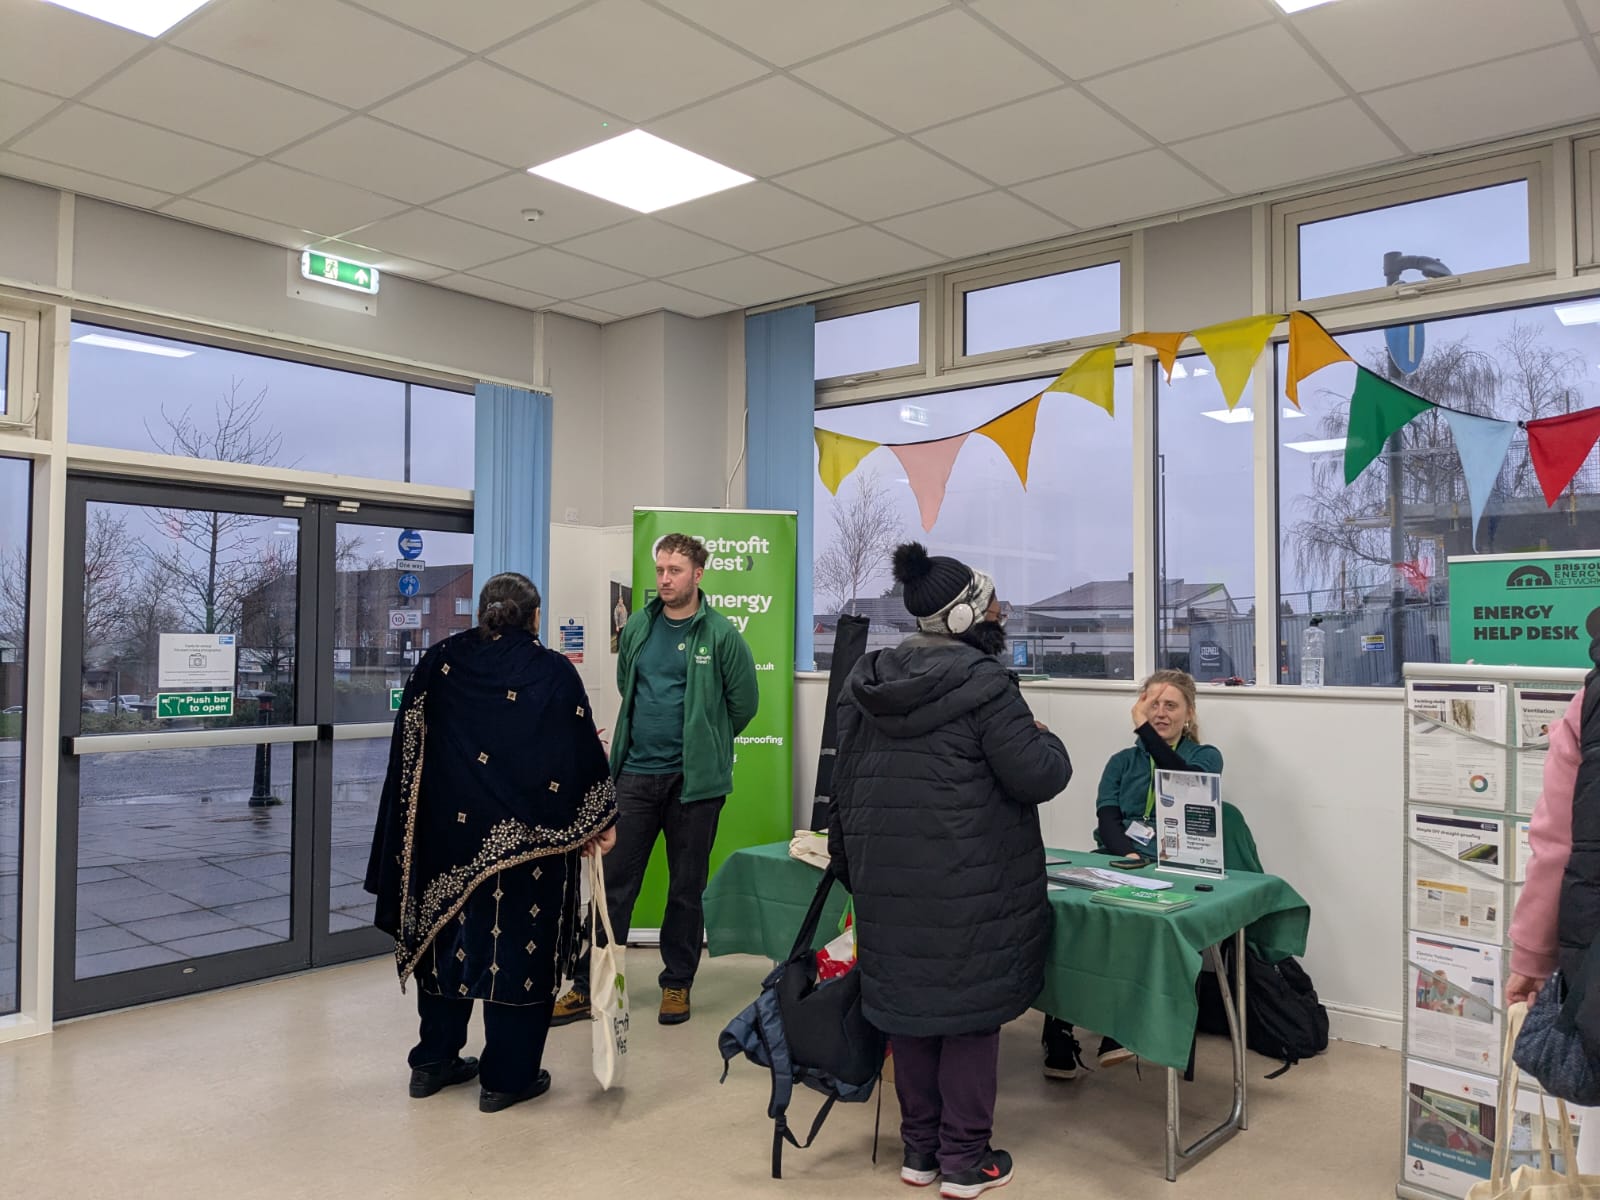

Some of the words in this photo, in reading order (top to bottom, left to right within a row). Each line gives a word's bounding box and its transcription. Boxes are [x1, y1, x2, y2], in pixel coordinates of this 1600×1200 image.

[1473, 604, 1554, 620] ENERGY
[1473, 626, 1523, 640] HELP
[1526, 625, 1580, 640] DESK
[186, 696, 211, 704] Push
[213, 695, 230, 703] bar
[202, 704, 227, 713] open
